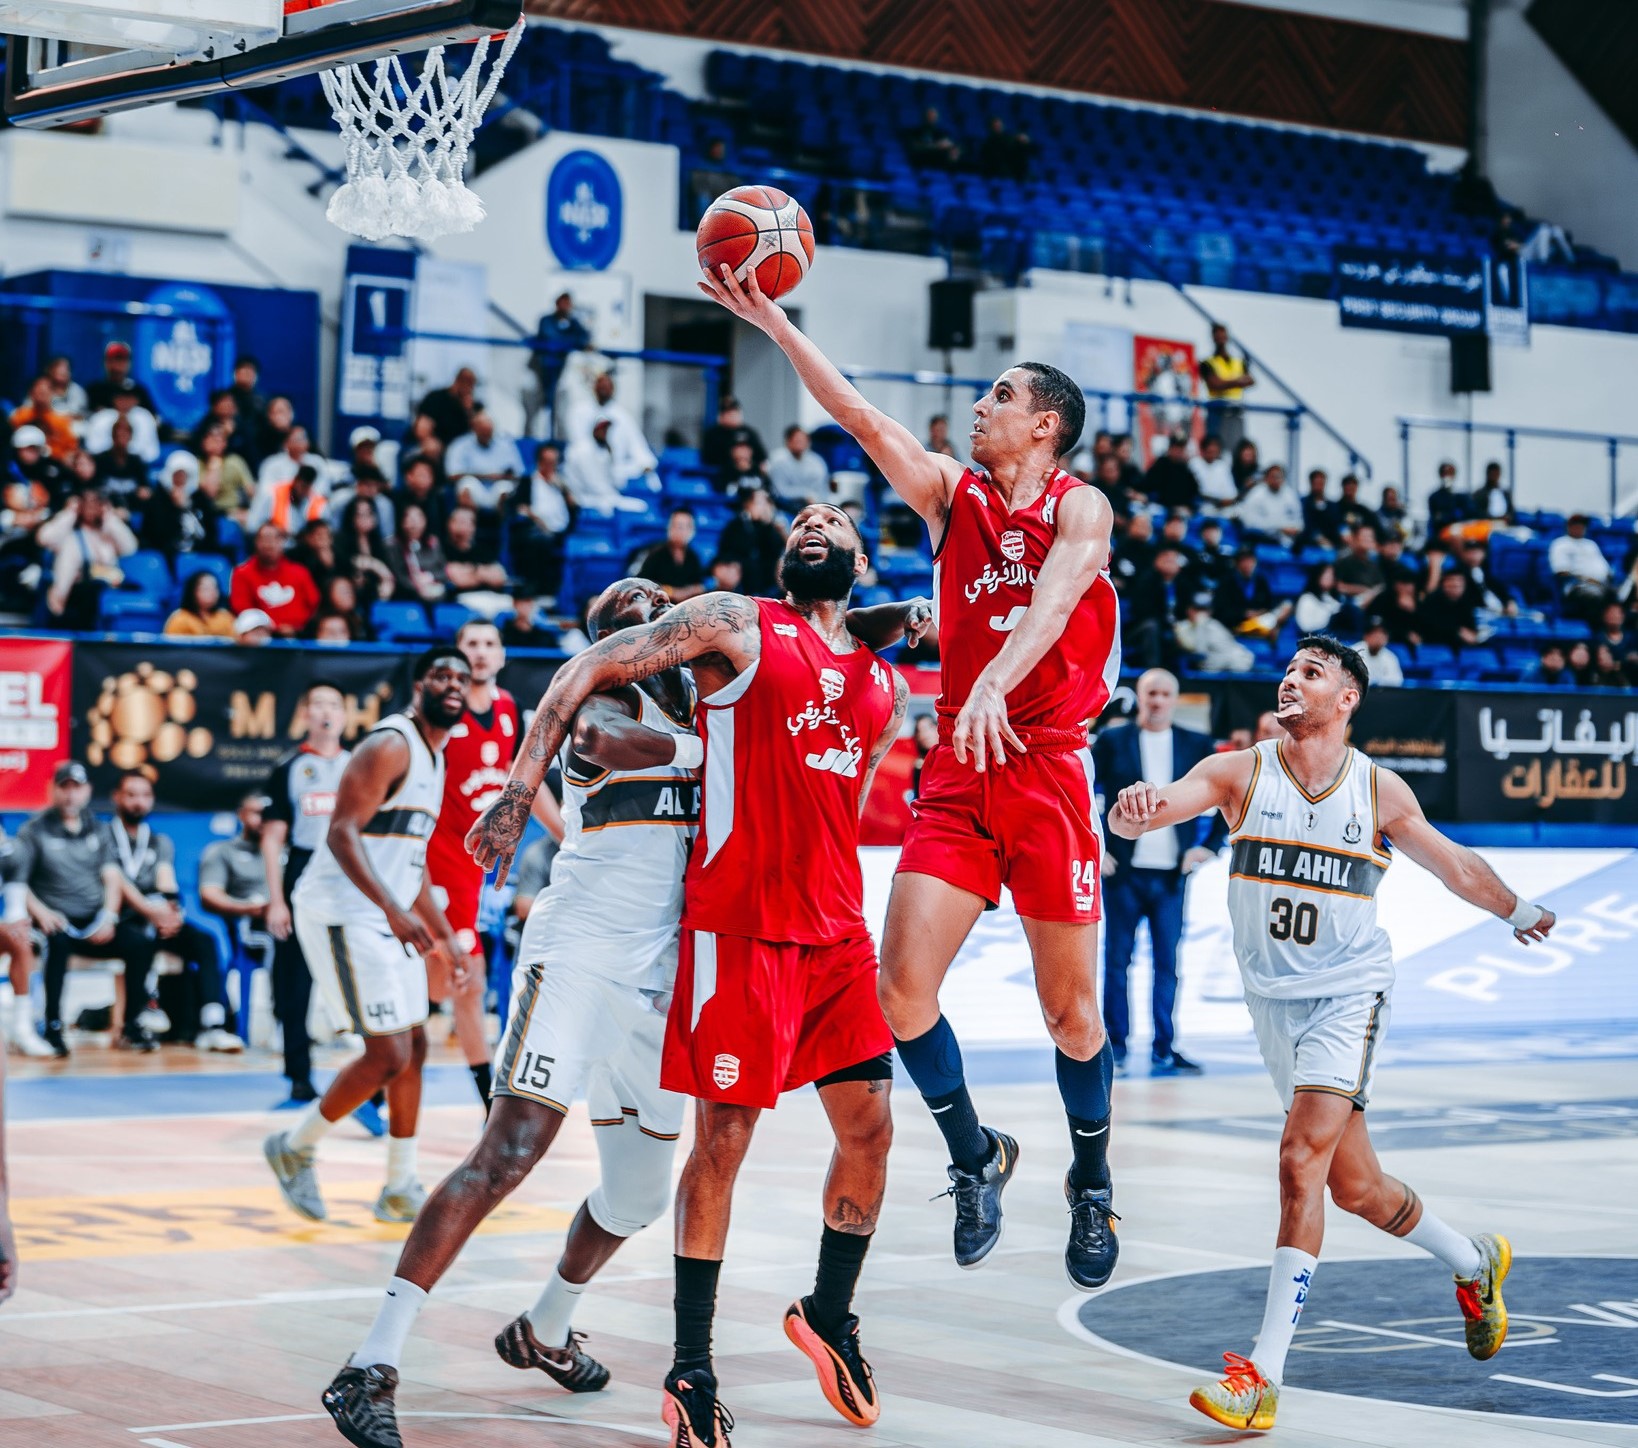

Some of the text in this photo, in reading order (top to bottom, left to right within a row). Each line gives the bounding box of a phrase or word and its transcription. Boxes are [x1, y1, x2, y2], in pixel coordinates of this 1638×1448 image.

[1072, 860, 1095, 893] 24
[1258, 847, 1352, 888] AL AHLI
[1269, 897, 1318, 945] 30
[367, 1000, 399, 1025] 44
[518, 1051, 555, 1089] 15
